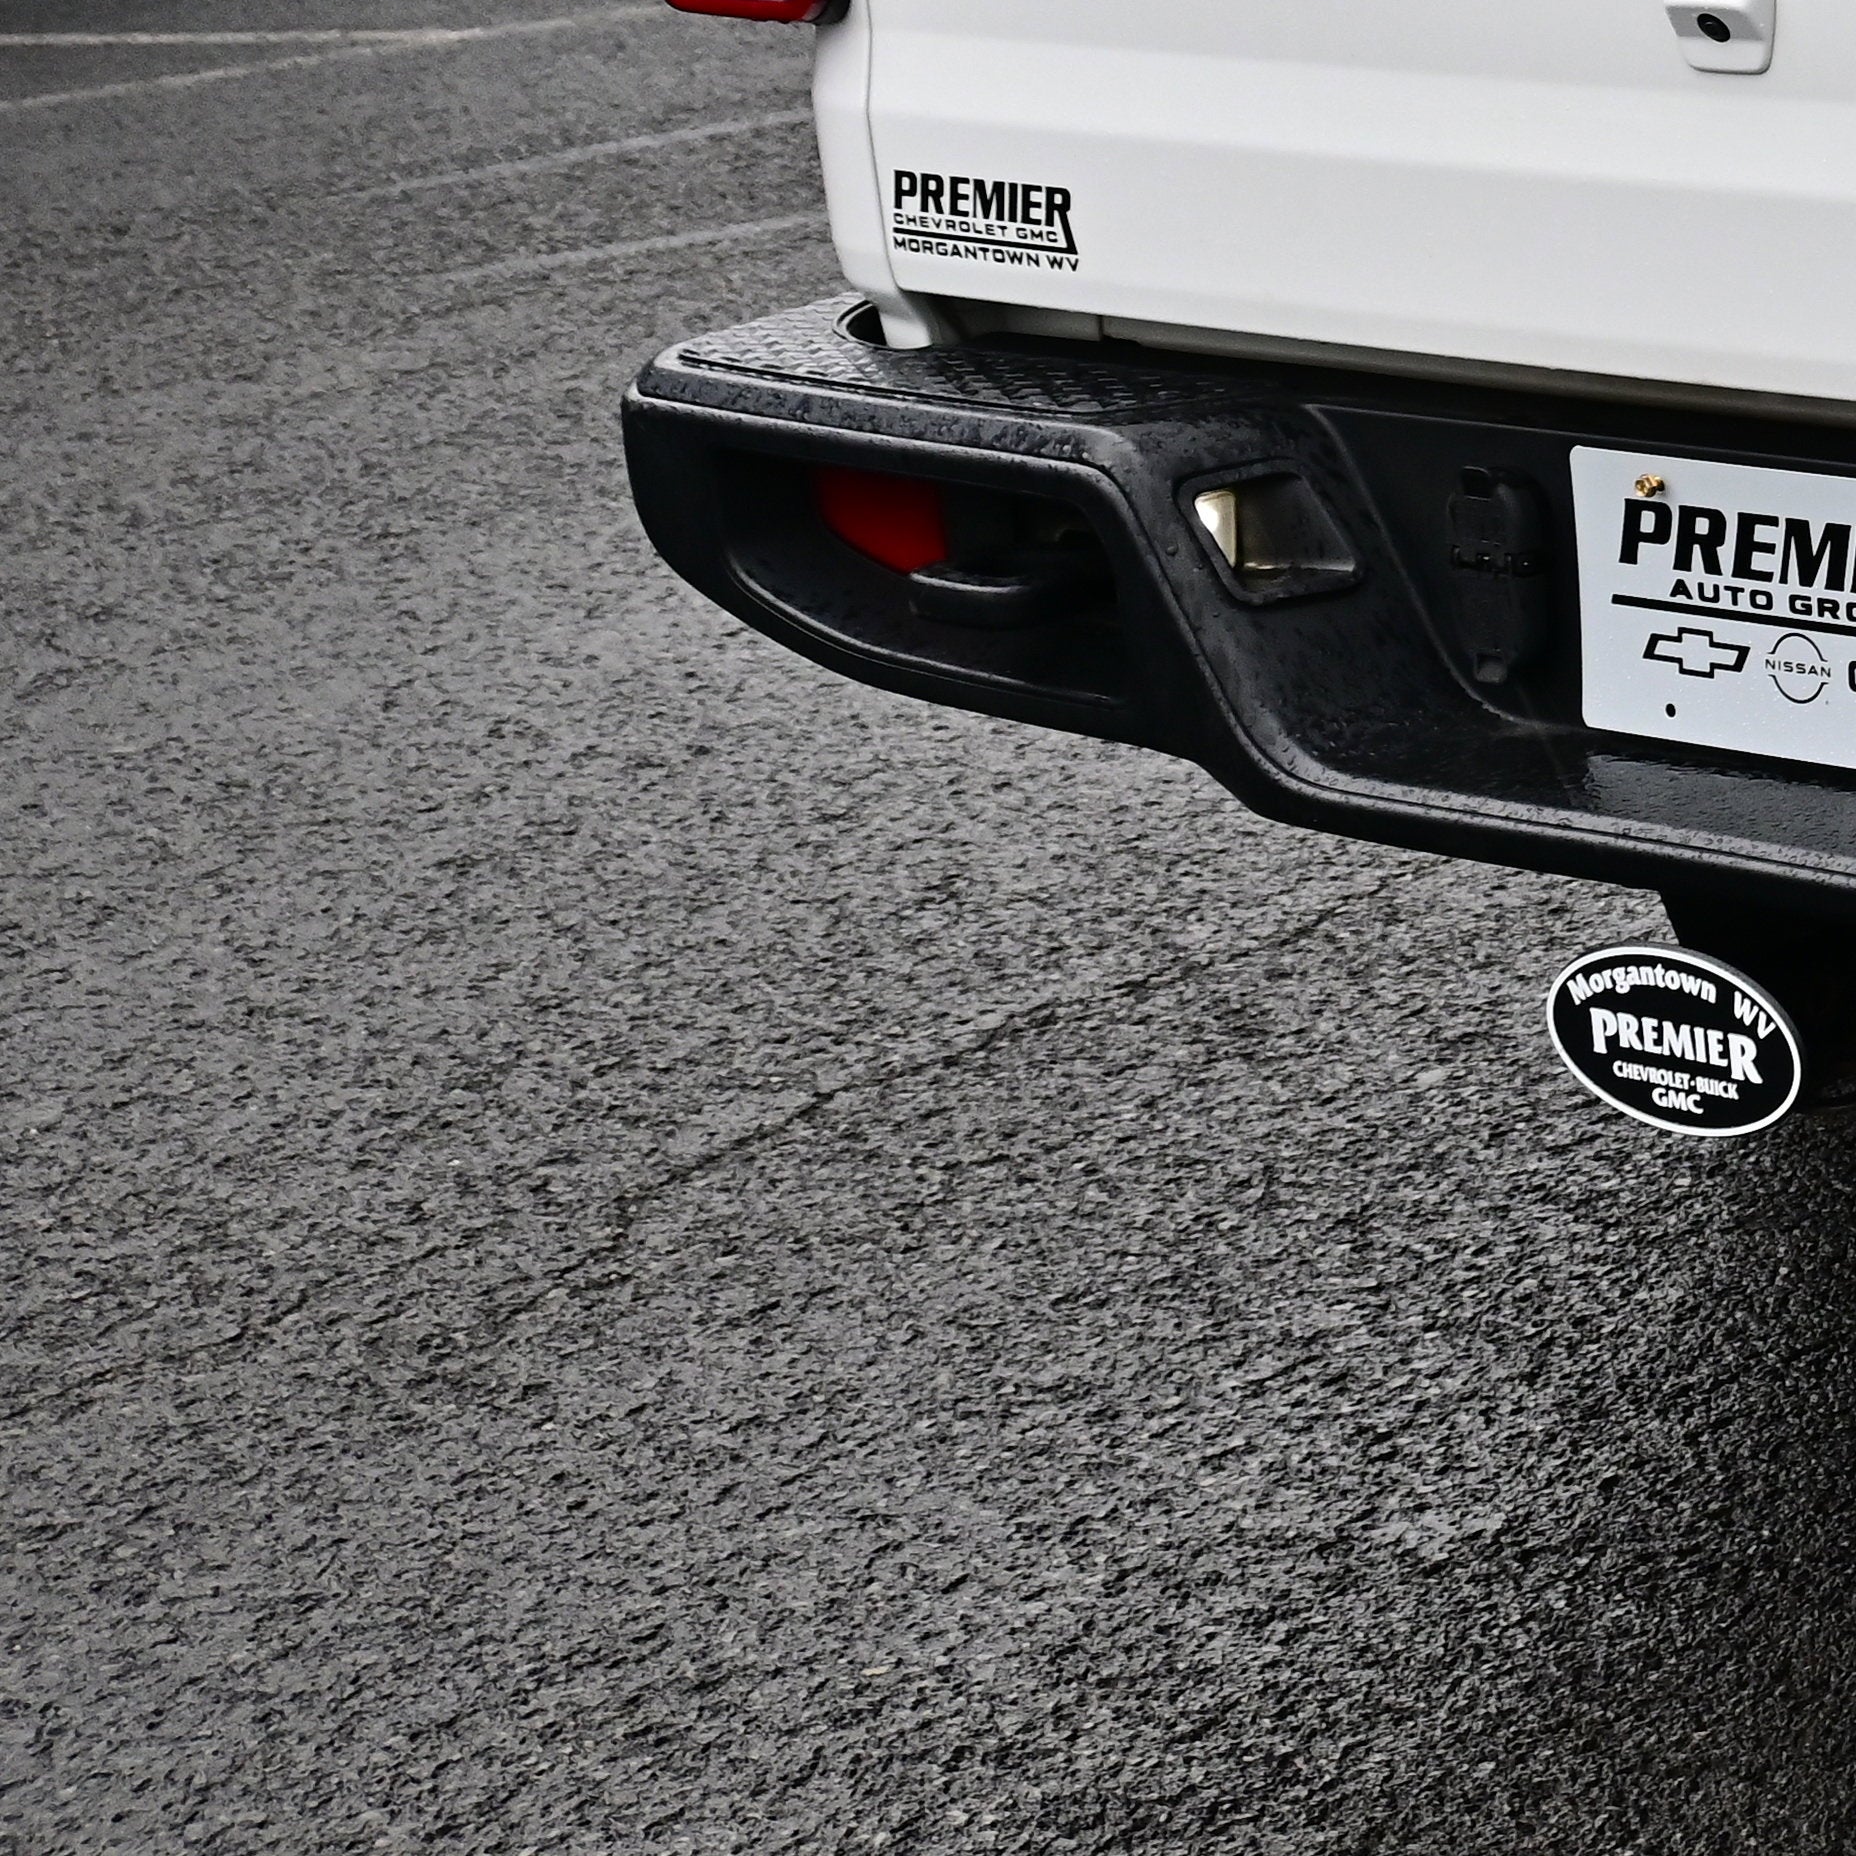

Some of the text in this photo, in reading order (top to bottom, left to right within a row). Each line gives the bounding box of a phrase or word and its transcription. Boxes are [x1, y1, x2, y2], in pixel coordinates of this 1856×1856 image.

[893, 169, 1075, 230] PREMIER
[893, 212, 1059, 243] CHEVROLET GMC
[893, 236, 1079, 272] MORGANTOWN WV
[1669, 578, 1774, 611] AUTO
[1764, 657, 1832, 679] NISSAN
[1566, 962, 1777, 1040] Morgantown WV
[1589, 1007, 1764, 1085] PREMIER
[1651, 1087, 1704, 1115] GMC
